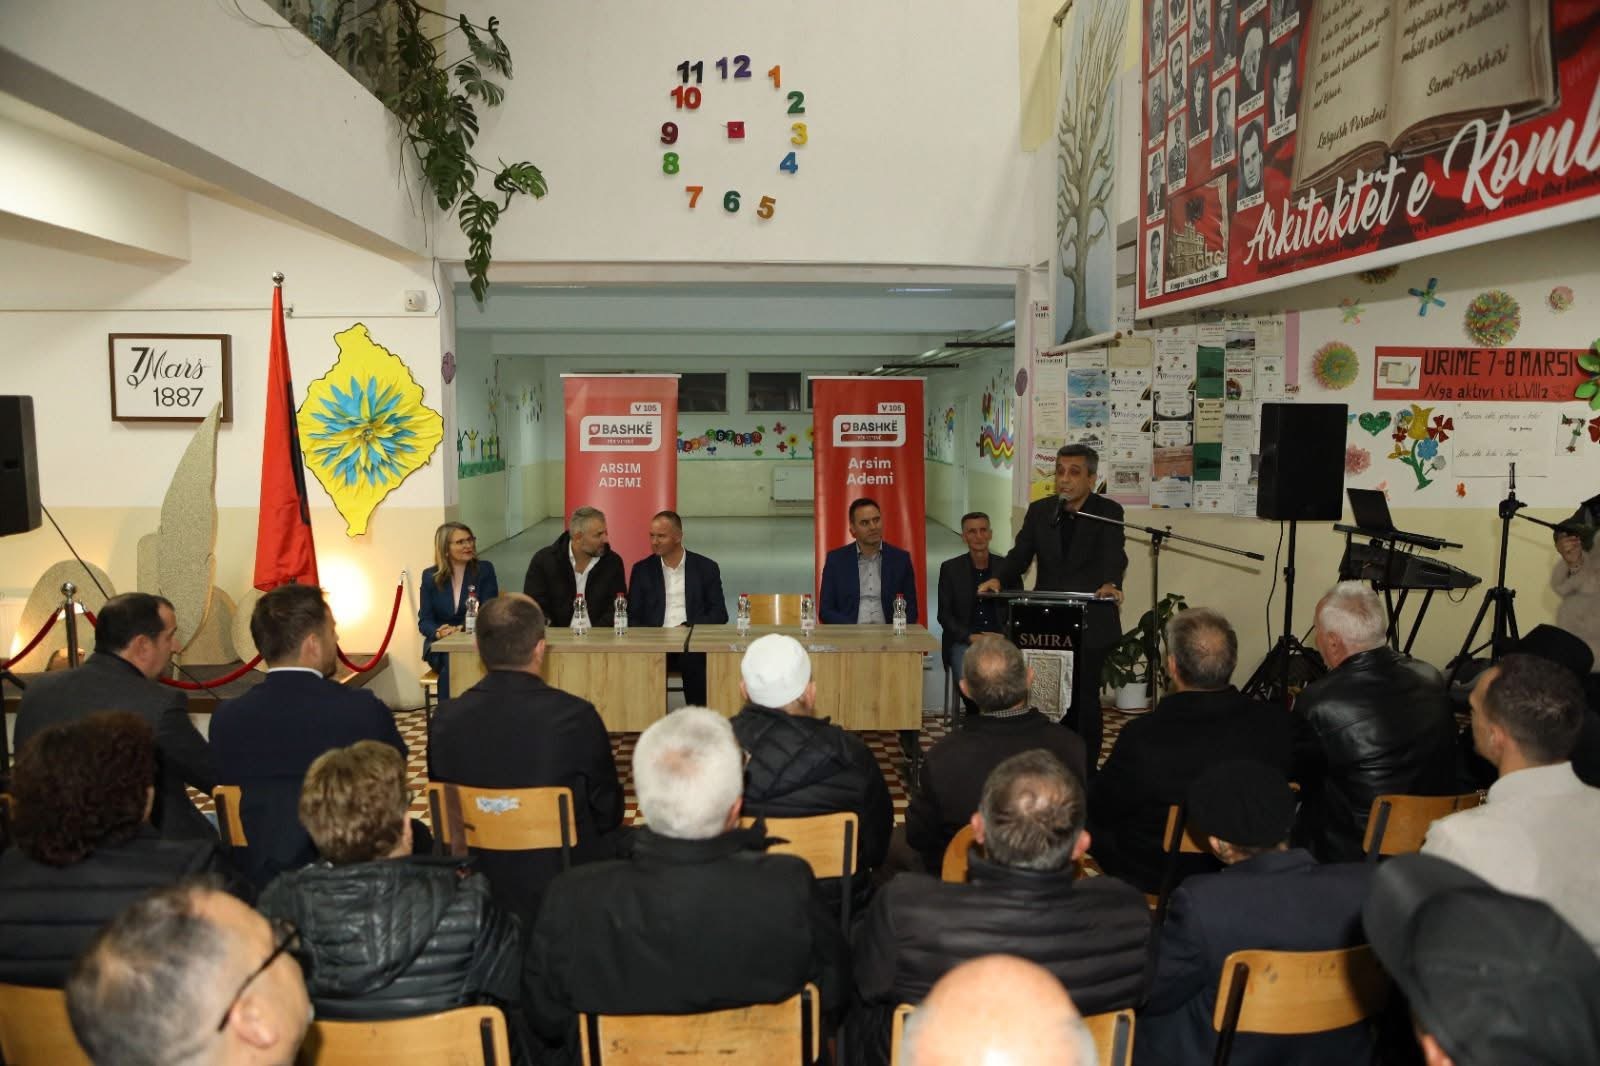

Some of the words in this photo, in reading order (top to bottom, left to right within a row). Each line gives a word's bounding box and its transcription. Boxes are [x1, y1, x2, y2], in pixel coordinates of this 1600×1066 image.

[677, 61, 704, 83] 11
[715, 55, 752, 80] 12
[768, 65, 781, 88] 1
[671, 85, 702, 109] 10
[787, 91, 805, 114] 2
[661, 122, 679, 145] 9
[790, 122, 808, 145] 3
[663, 152, 680, 175] 8
[780, 152, 798, 174] 4
[686, 186, 703, 209] 7
[723, 190, 741, 213] 6
[757, 195, 776, 219] 5
[126, 347, 205, 389] Mars
[131, 346, 150, 373] 7
[1424, 350, 1481, 376] URIME
[1520, 352, 1573, 376] MARSI
[153, 387, 204, 407] 1887
[602, 421, 653, 435] BASHKË
[852, 420, 898, 432] BASHKË
[600, 463, 641, 474] ARSIM
[848, 457, 892, 469] Arsim
[599, 477, 641, 488] ADEMI
[846, 472, 894, 485] Ademi
[1020, 633, 1073, 648] SMIRA
